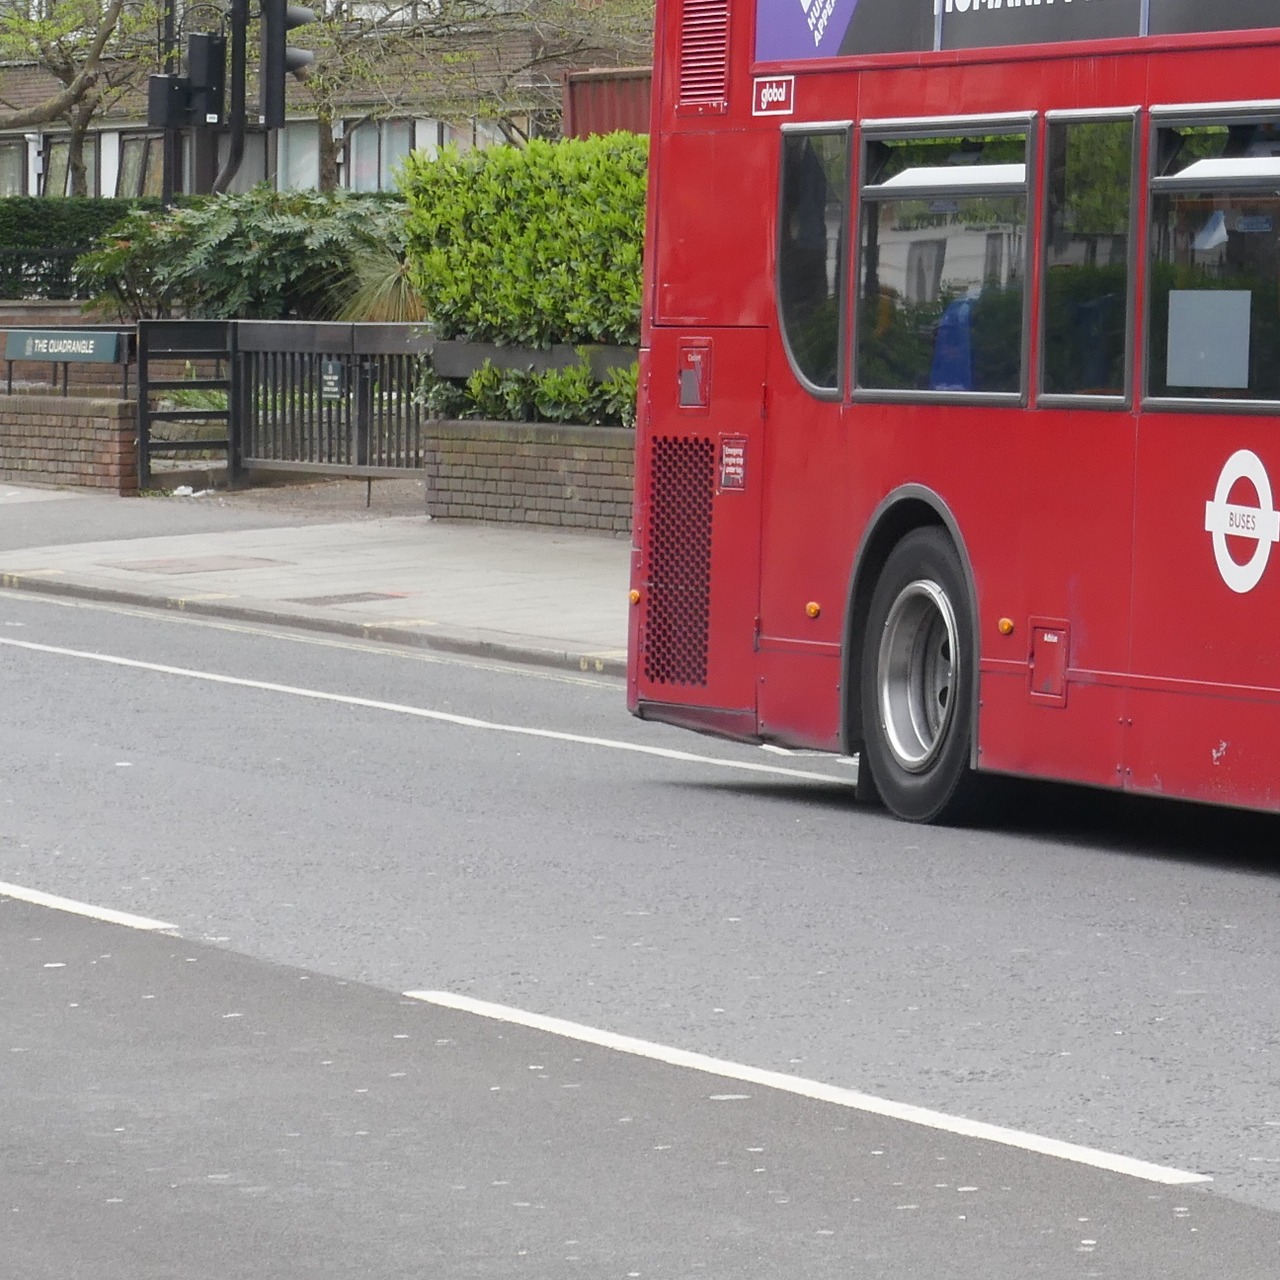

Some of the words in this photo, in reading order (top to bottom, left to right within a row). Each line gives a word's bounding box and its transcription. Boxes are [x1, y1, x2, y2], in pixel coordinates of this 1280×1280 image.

[761, 81, 786, 110] global
[34, 339, 48, 352] THE
[48, 340, 94, 353] QUADRANGLE
[1228, 511, 1256, 531] BUSES
